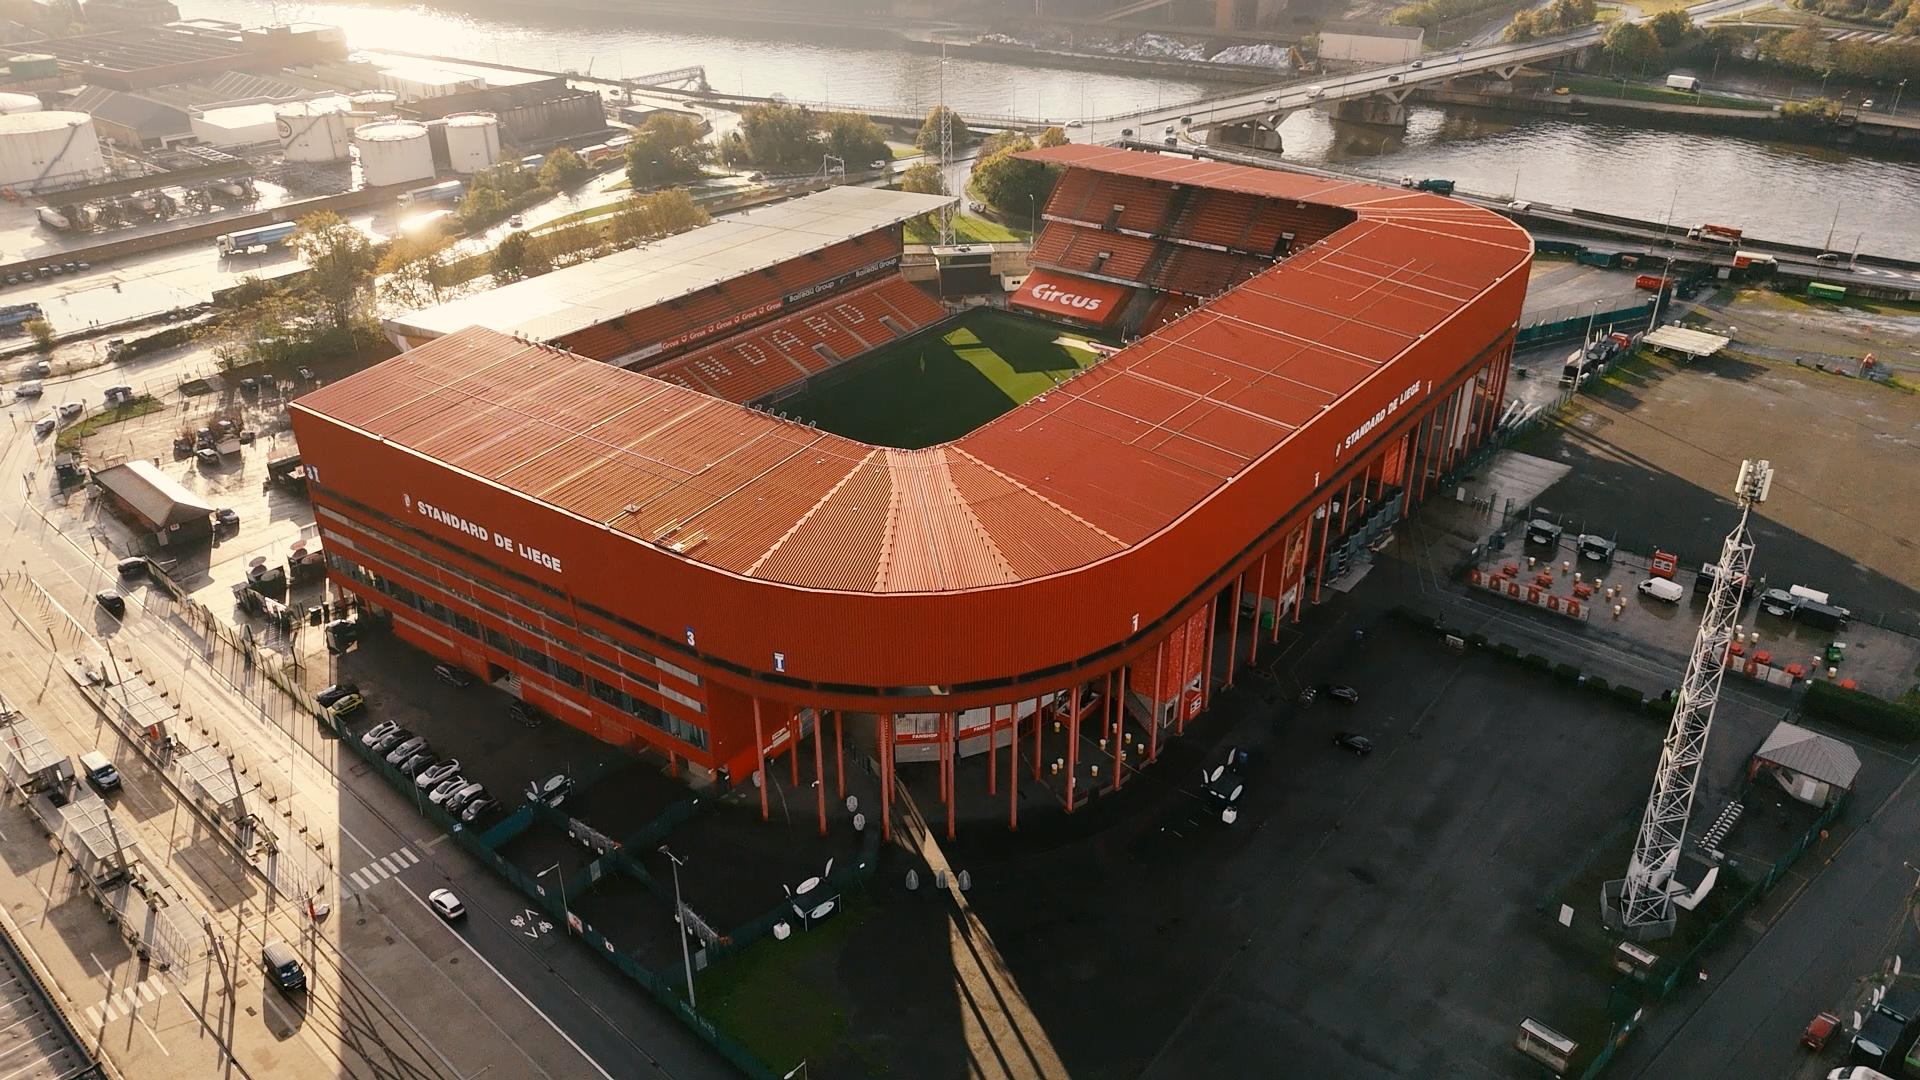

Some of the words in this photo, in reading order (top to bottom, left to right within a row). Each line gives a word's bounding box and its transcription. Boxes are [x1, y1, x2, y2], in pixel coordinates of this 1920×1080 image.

[879, 257, 897, 269] Group
[815, 281, 835, 293] Group
[1032, 283, 1103, 311] Circus
[1345, 408, 1386, 449] STANDARD
[1387, 398, 1399, 415] DE
[1399, 380, 1421, 406] LIEGE
[417, 501, 489, 542] STANDARD
[494, 533, 514, 553] DE
[519, 543, 563, 573] LIEGE
[912, 732, 938, 740] FANSHOP
